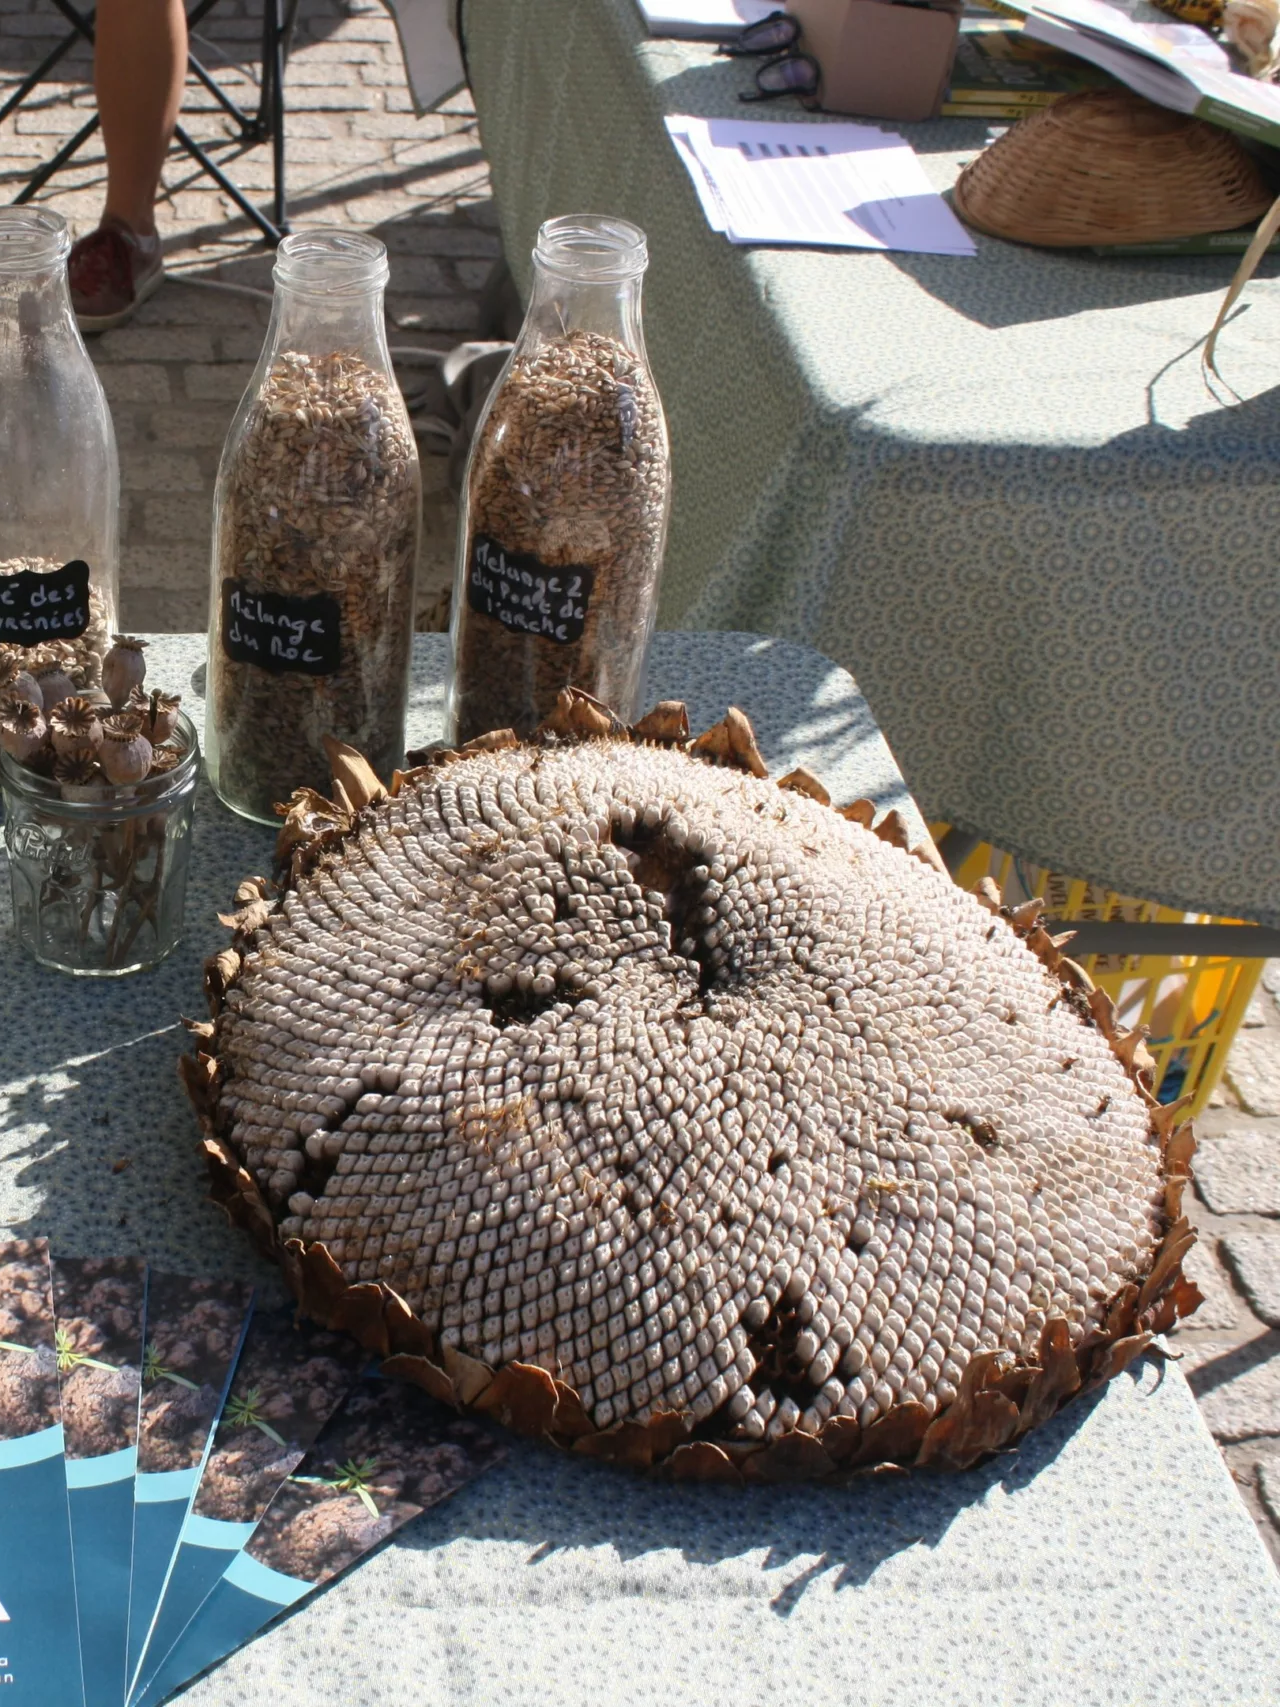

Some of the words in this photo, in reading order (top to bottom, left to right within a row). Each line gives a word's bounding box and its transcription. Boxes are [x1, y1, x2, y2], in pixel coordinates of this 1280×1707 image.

[30, 584, 76, 607] des
[471, 566, 494, 593] du
[559, 598, 584, 619] de
[567, 575, 582, 598] 2
[229, 621, 259, 650] du
[270, 635, 324, 662] Roc
